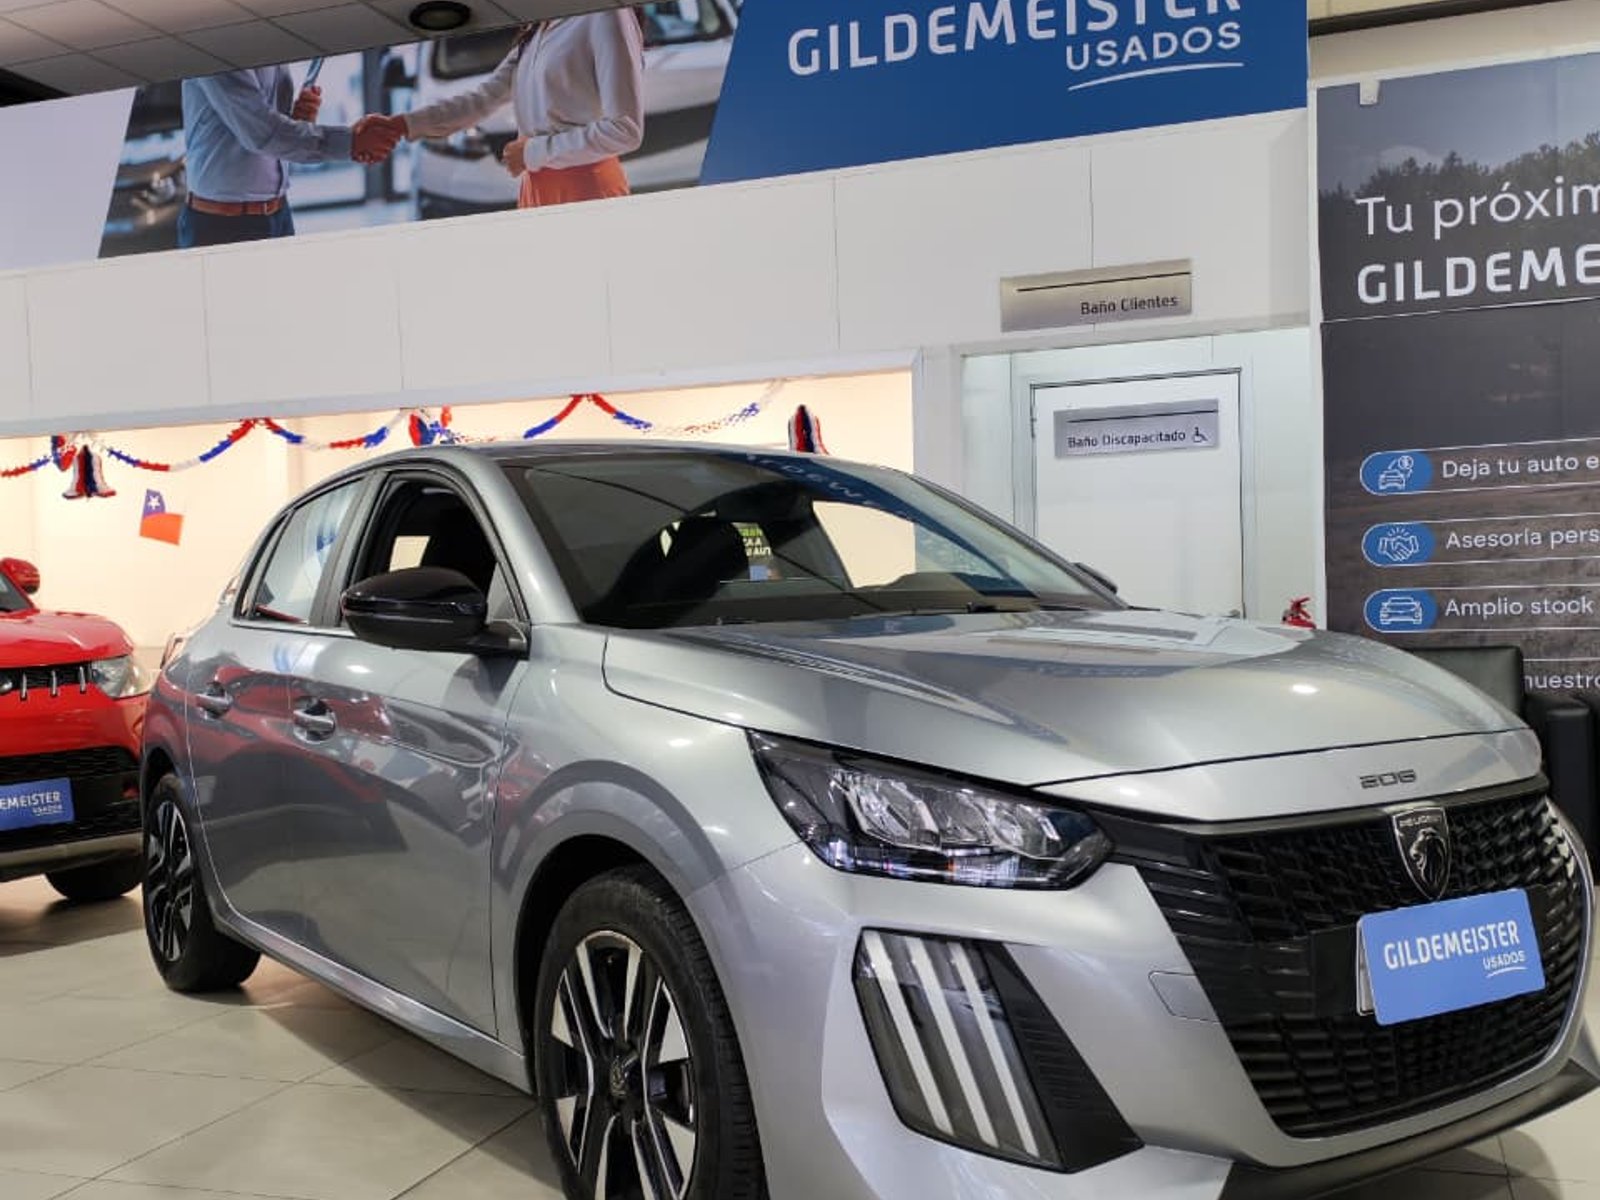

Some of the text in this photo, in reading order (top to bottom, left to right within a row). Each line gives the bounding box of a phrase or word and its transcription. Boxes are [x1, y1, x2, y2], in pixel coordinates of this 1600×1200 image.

[1066, 21, 1241, 71] USADOS
[1355, 181, 1600, 240] Tu próxim
[1357, 243, 1600, 304] GILDEME
[1081, 295, 1177, 315] Baño Clientes
[1067, 430, 1186, 448] Baño Discapacitado
[1442, 459, 1490, 480] Deja
[1498, 458, 1519, 475] tu
[1527, 455, 1579, 473] auto
[1446, 527, 1600, 550] Asesoría pers
[1445, 596, 1594, 620] Amplio stock
[1384, 920, 1520, 969] GILDEMEISTER
[1482, 950, 1526, 970] USADOS
